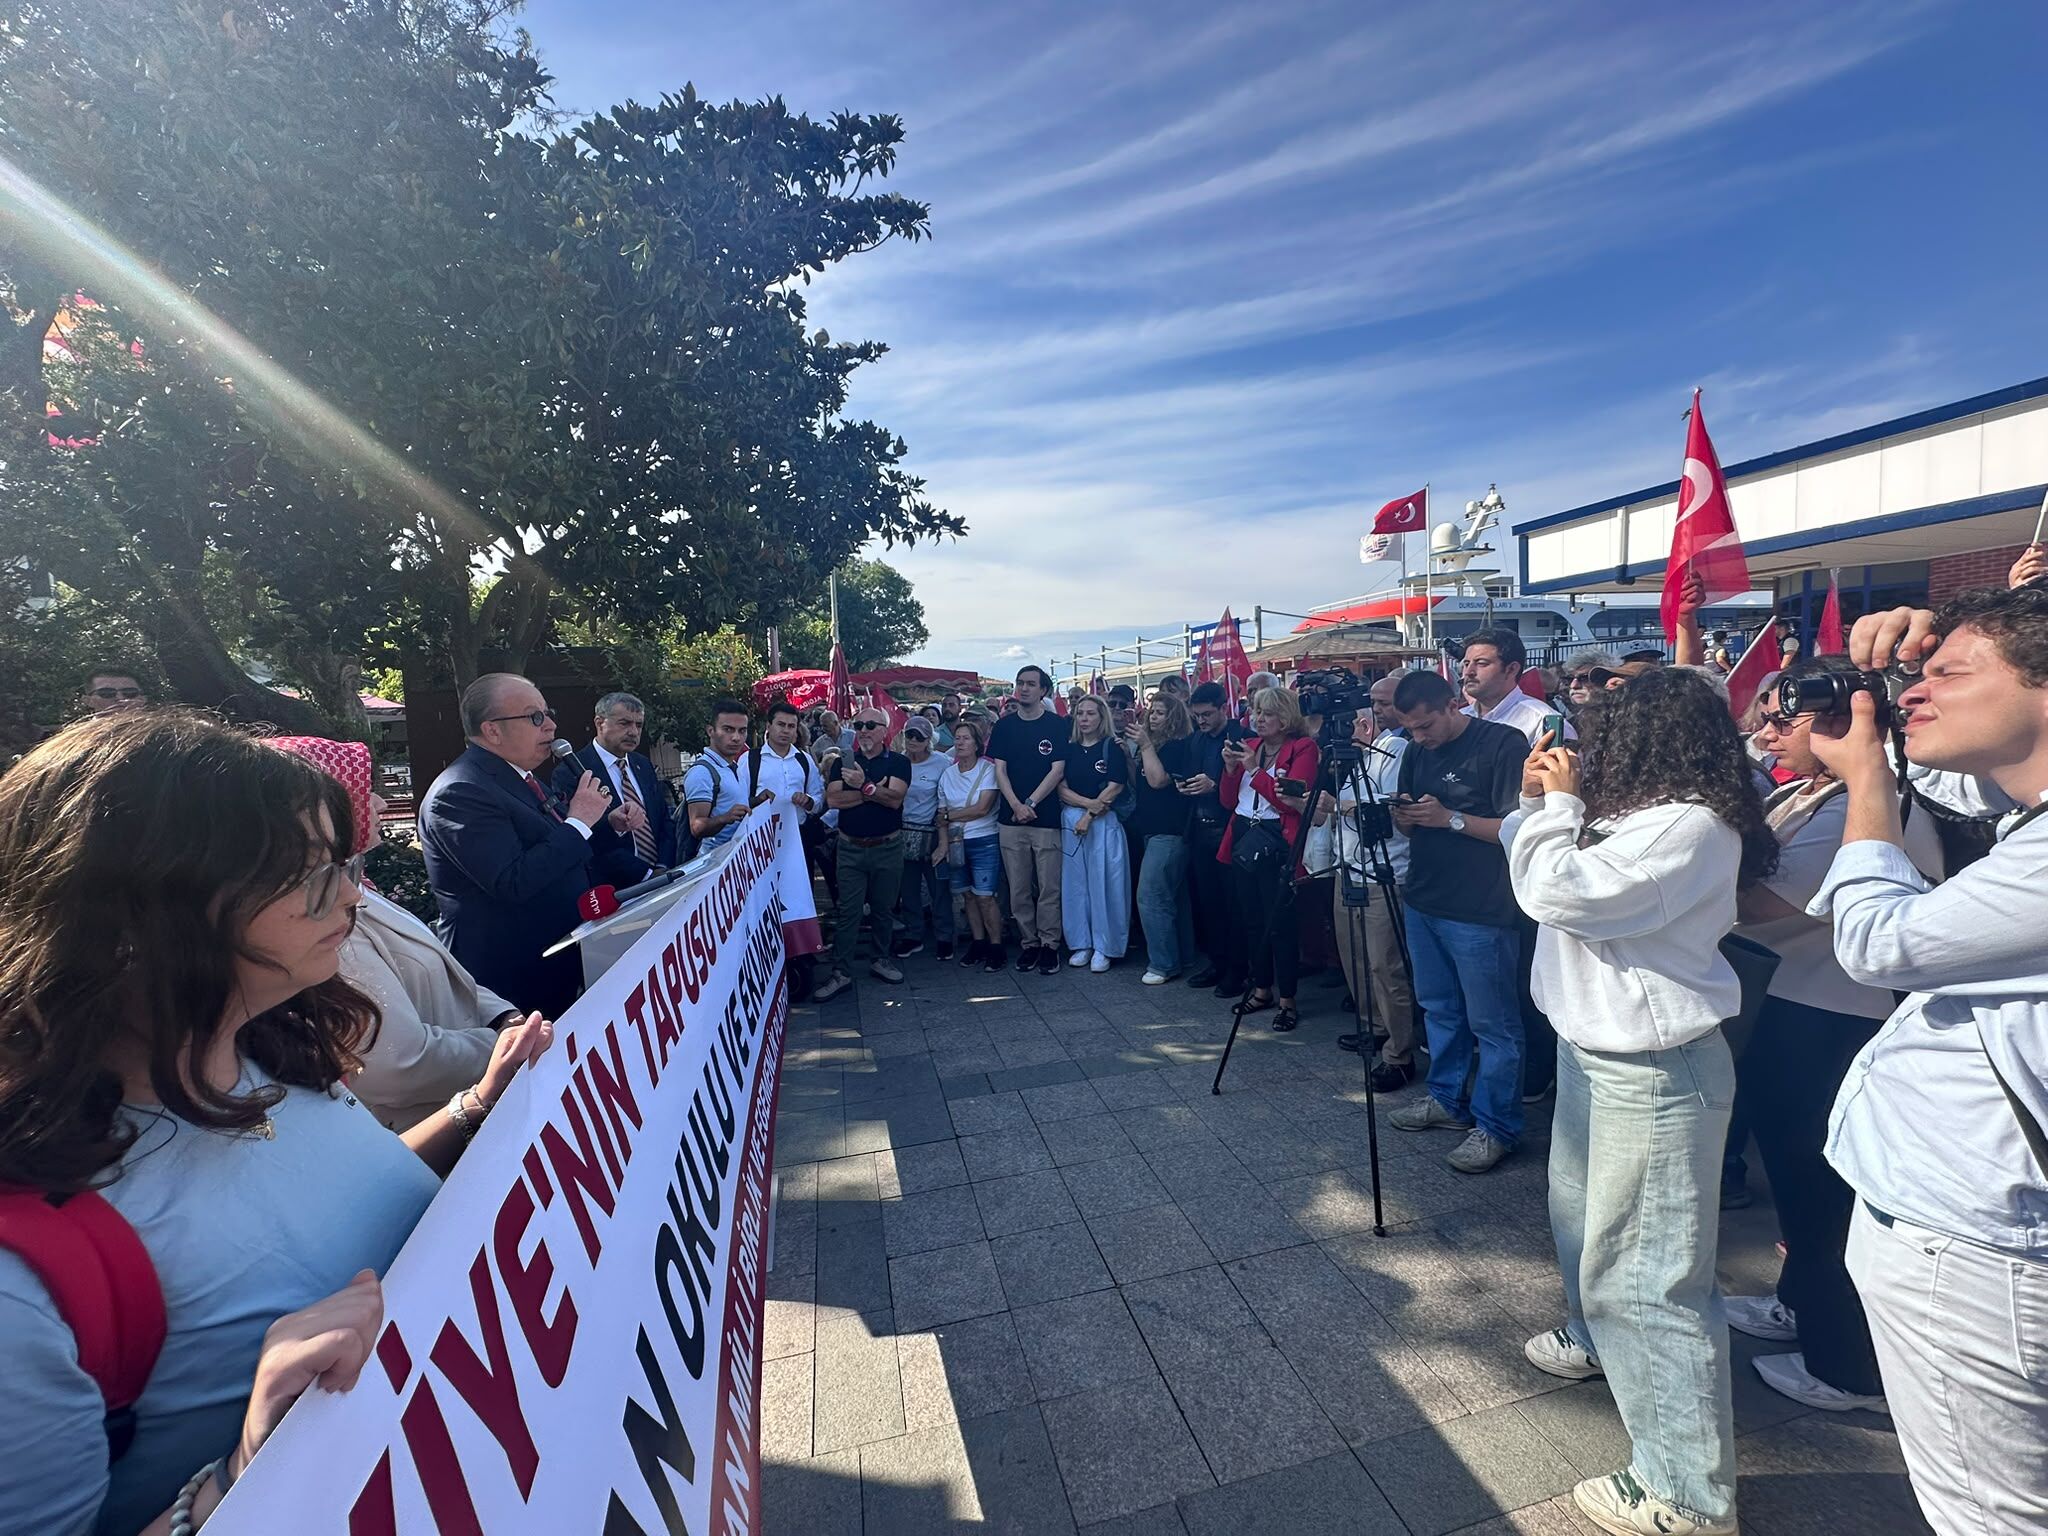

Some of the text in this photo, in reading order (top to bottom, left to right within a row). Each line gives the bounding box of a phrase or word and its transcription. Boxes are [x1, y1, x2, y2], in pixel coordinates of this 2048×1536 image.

[348, 1020, 643, 1536] İYE'NİN
[624, 895, 717, 1090] TAPUSU
[654, 1042, 735, 1380] OKULU
[717, 989, 750, 1093] VE
[737, 1161, 762, 1300] BİRLİK
[748, 1124, 766, 1180] VE
[727, 1266, 755, 1452] MİLLİ
[722, 1428, 750, 1536] AN
